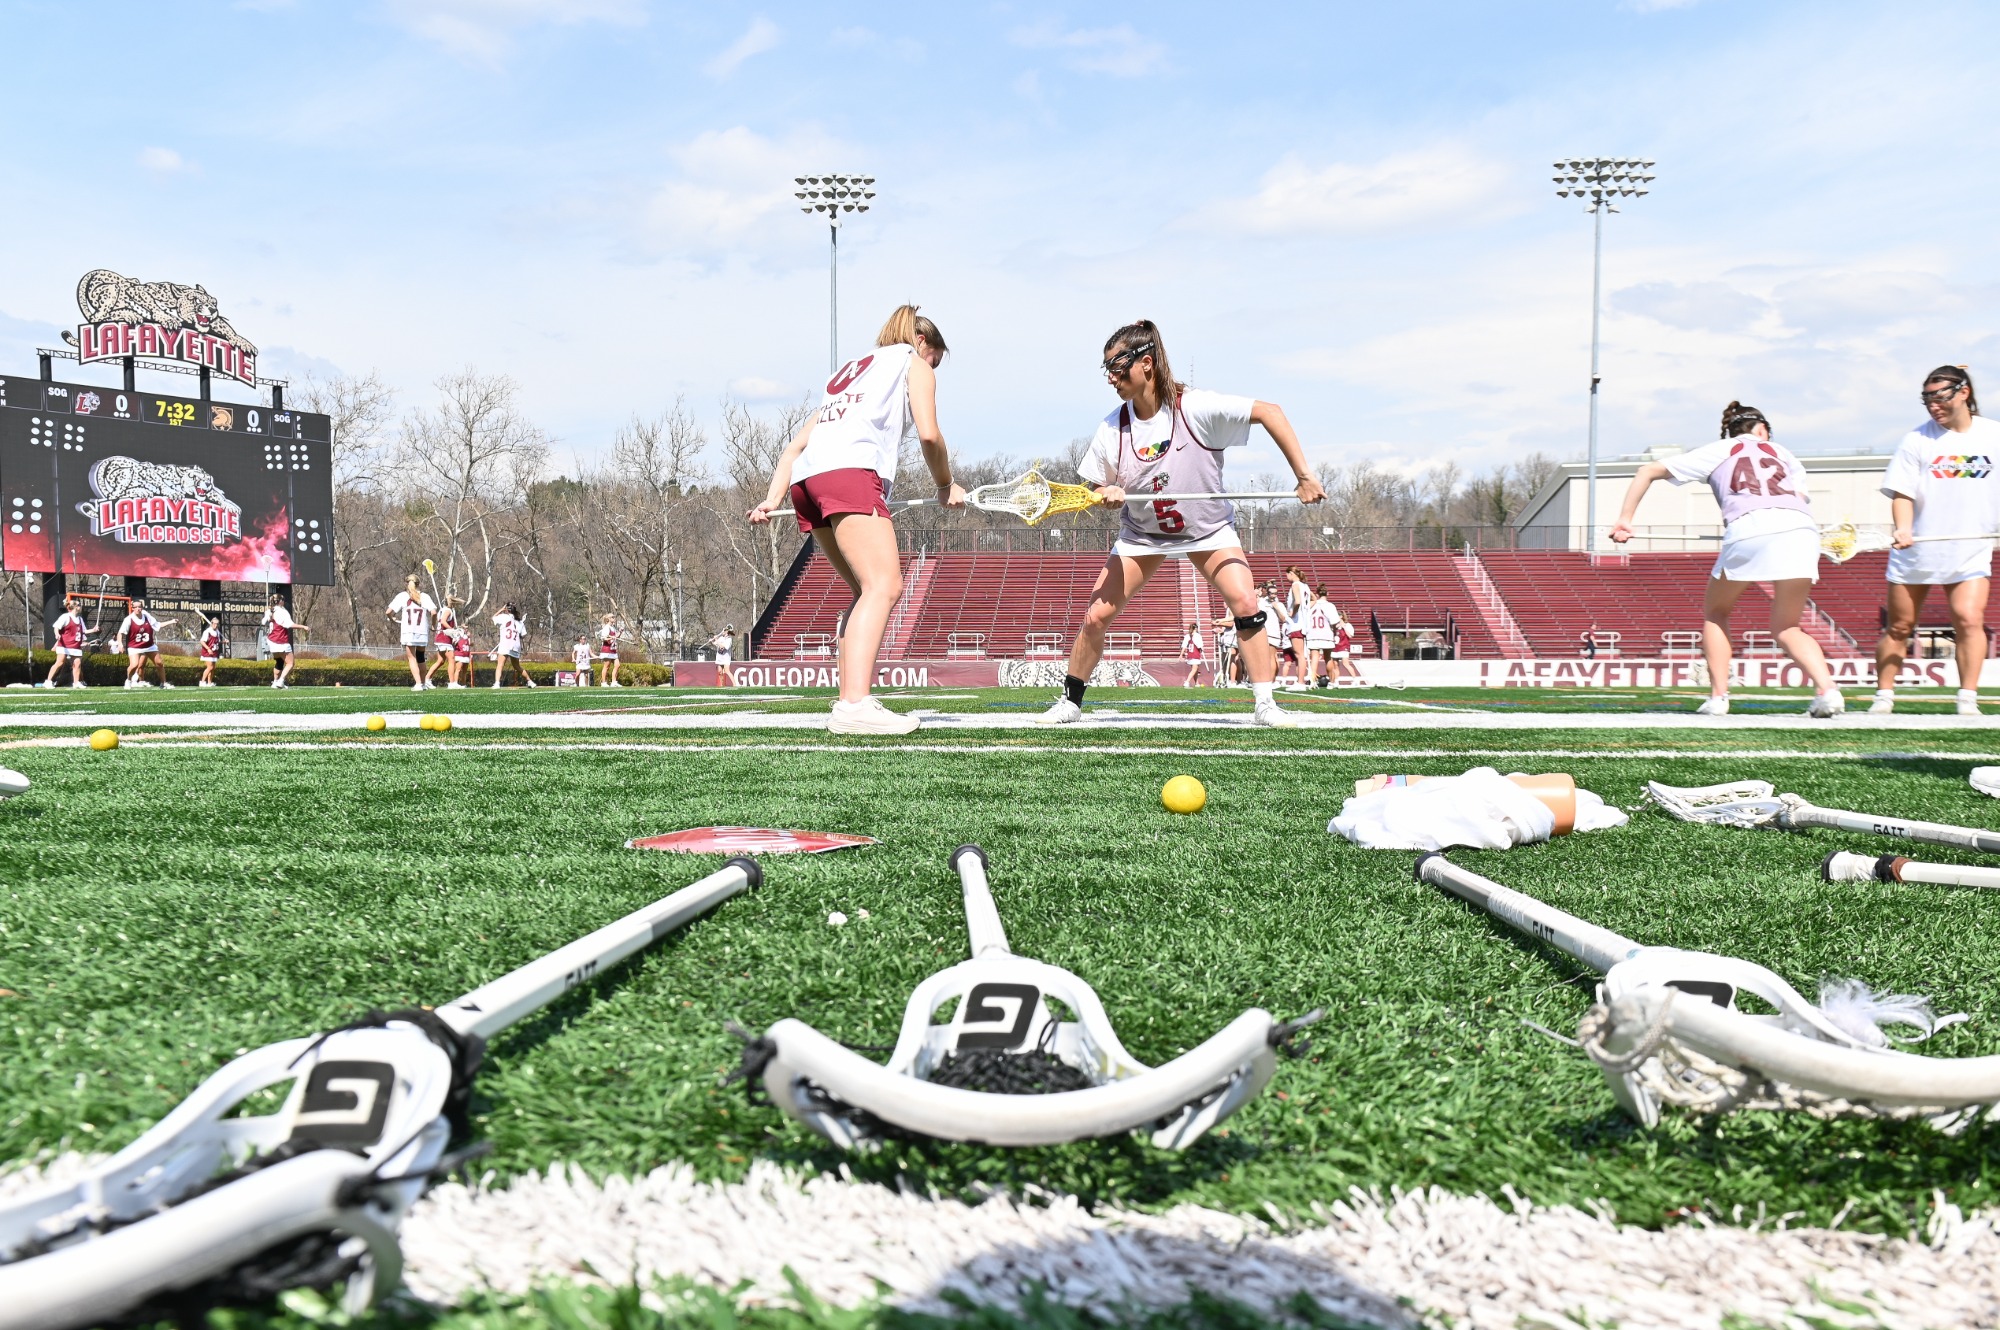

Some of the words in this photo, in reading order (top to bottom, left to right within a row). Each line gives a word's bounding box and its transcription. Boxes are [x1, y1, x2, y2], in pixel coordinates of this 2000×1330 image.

[80, 322, 256, 382] LAFAYETTE
[47, 386, 68, 398] SOG
[115, 394, 128, 412] 0
[155, 400, 196, 420] 7:32
[169, 418, 183, 427] 1ST
[247, 410, 260, 428] 0
[273, 413, 291, 423] SOG
[1730, 456, 1796, 497] 42
[100, 497, 240, 536] LAFAYETTE
[1153, 499, 1185, 534] 5
[126, 524, 222, 544] LACROSSE
[150, 600, 179, 609] Fisher
[180, 600, 223, 612] Memorial
[406, 608, 424, 626] 17
[1312, 616, 1325, 629] 10
[135, 632, 150, 643] 23
[1480, 662, 1690, 687] LAFAYETTE
[1873, 823, 1905, 839] GAIT
